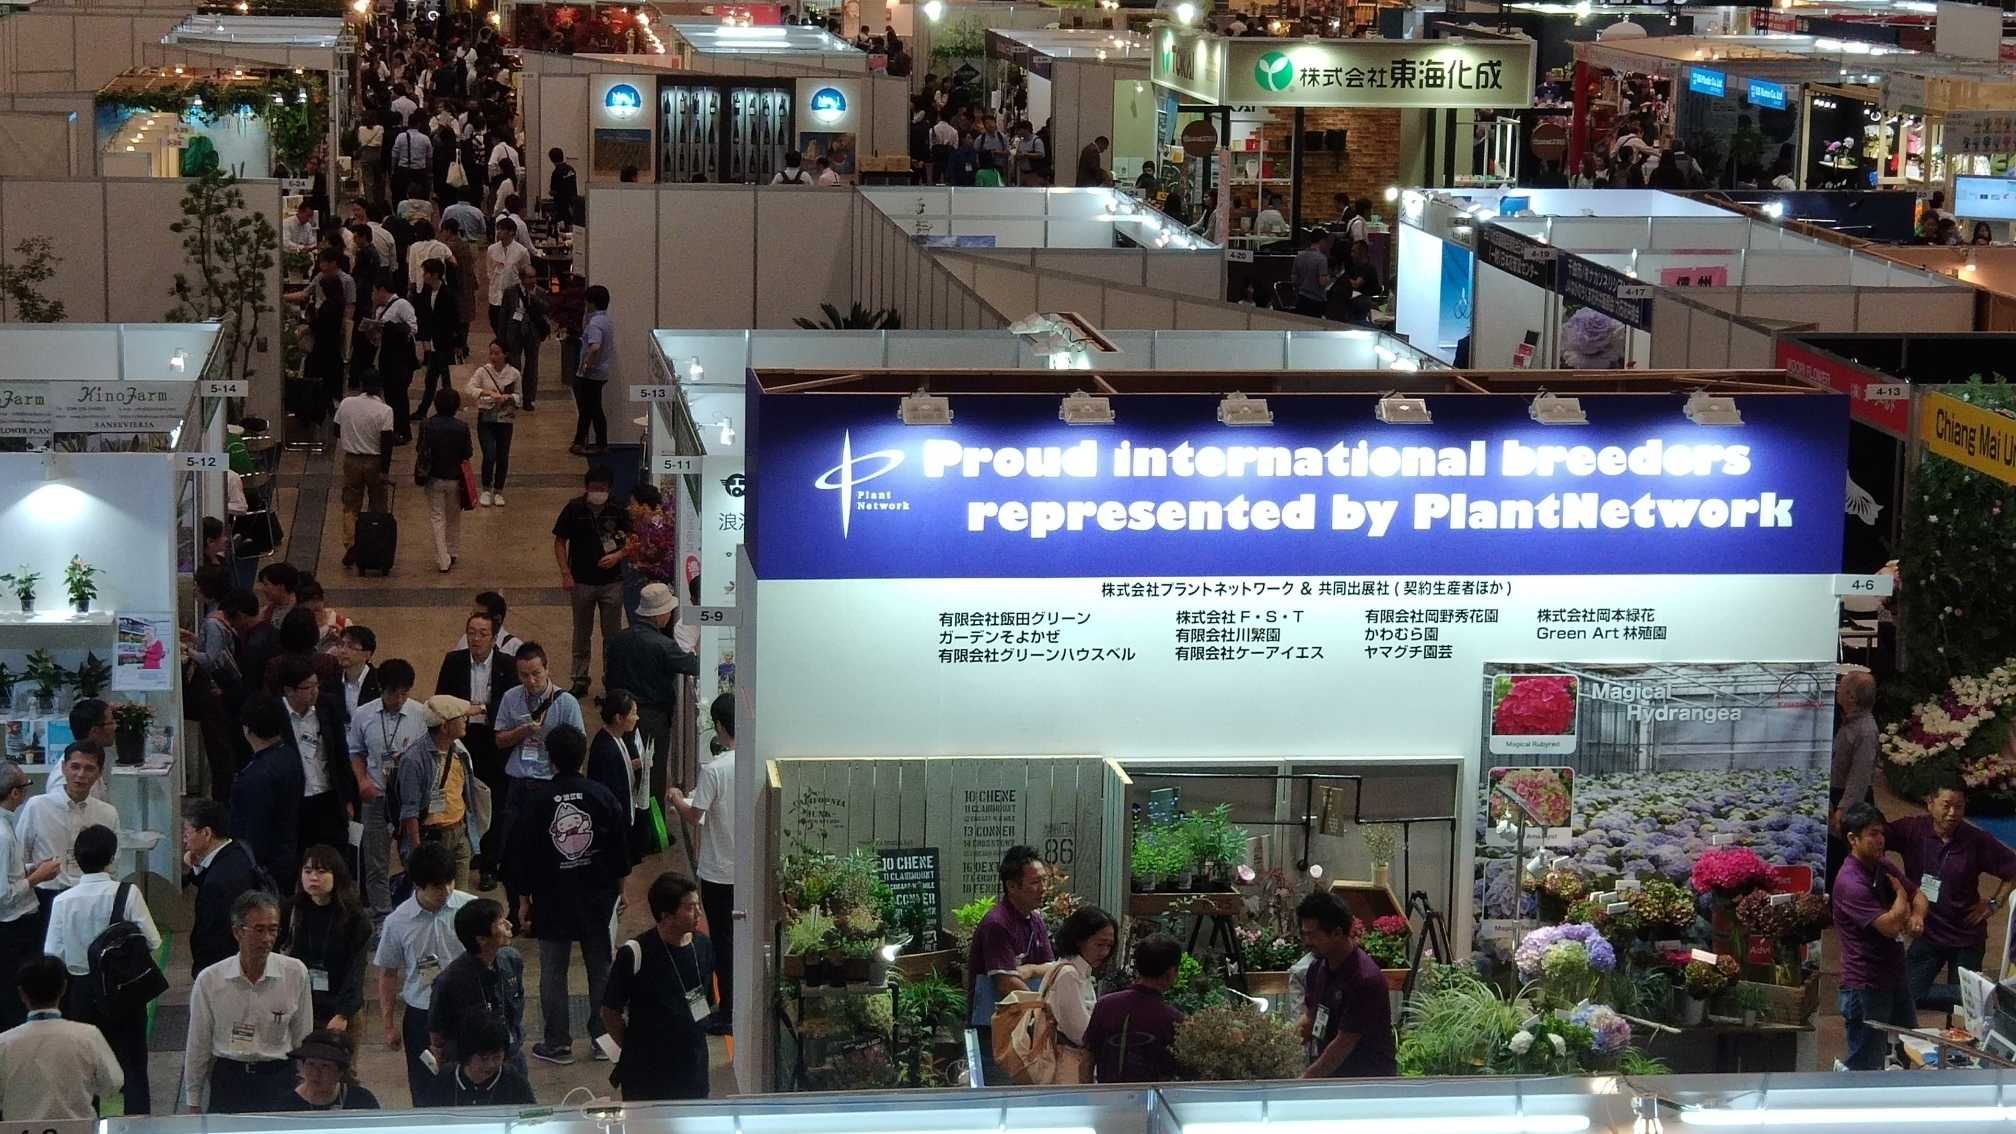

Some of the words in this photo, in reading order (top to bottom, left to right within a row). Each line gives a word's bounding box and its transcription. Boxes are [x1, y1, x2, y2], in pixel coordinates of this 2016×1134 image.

[1299, 58, 1503, 90] 株式会社東海化成
[1229, 252, 1247, 261] 4-20
[1625, 288, 1646, 297] 4-17
[210, 383, 237, 394] 5-14
[640, 389, 666, 399] 5-13
[1876, 387, 1901, 397] 4-13
[1936, 408, 1977, 457] Chiang
[1980, 425, 2002, 460] Mai
[186, 456, 217, 467] 5-12
[664, 460, 691, 470] 5-11
[924, 439, 1098, 478] Proud
[1113, 439, 1487, 478] international
[1502, 438, 1753, 477] breeders
[857, 490, 892, 500] Plant
[857, 501, 910, 511] Network
[967, 493, 1316, 539] represented
[1331, 493, 1399, 538] by
[1413, 492, 1795, 530] PlantNetwork
[1101, 581, 1294, 598] 株式会社プラントネットワーク
[1300, 581, 1312, 596] &
[1851, 579, 1875, 590] 4-6
[700, 610, 724, 622] 5-9
[938, 611, 1091, 627] 有限会社飯田グリーン
[1364, 608, 1499, 624] 有限会社岡野秀花園
[1536, 607, 1656, 623] 株式会社岡本緑花
[939, 629, 1061, 645] ガーデンそよかぜ
[1175, 627, 1281, 643] 有限会社川繁園
[1364, 627, 1439, 642] かわむら園
[1536, 626, 1587, 640] Green
[1592, 626, 1620, 640] Art
[938, 647, 1136, 664] 有限会社グリーンハウスベル
[1175, 645, 1325, 661] 有限会社ケーアイエス
[1364, 644, 1453, 660] ヤマグチ園芸
[1592, 682, 1673, 703] Magical
[1626, 703, 1743, 724] Hydrangea
[964, 790, 976, 802] 10
[977, 789, 1017, 803] CHENE
[963, 826, 974, 837] 13
[1045, 837, 1074, 865] 86
[896, 855, 935, 871] CHENE
